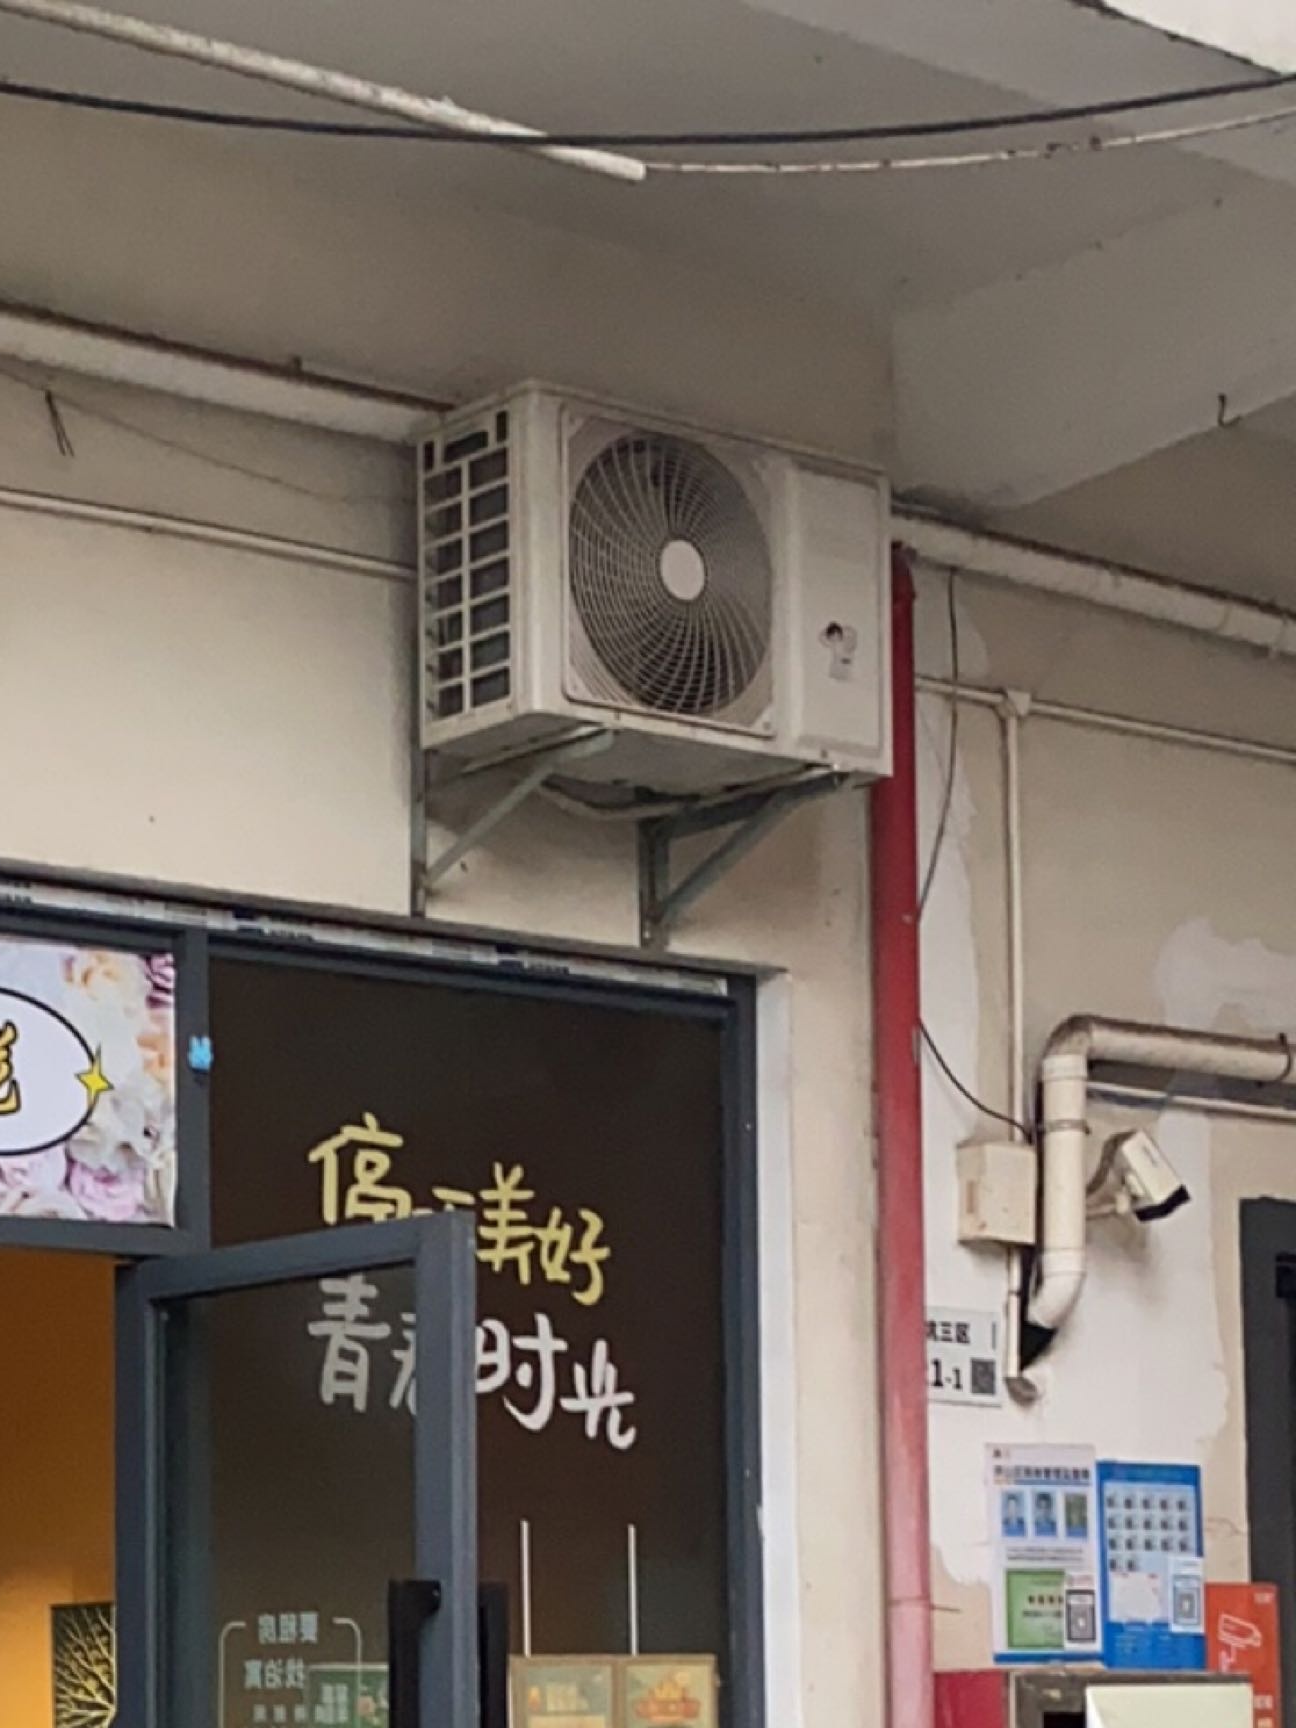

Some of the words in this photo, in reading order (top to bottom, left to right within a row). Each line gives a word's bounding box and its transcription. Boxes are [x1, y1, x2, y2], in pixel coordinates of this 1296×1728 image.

[308, 1112, 611, 1306] 停美好
[307, 1272, 637, 1450] 青时光
